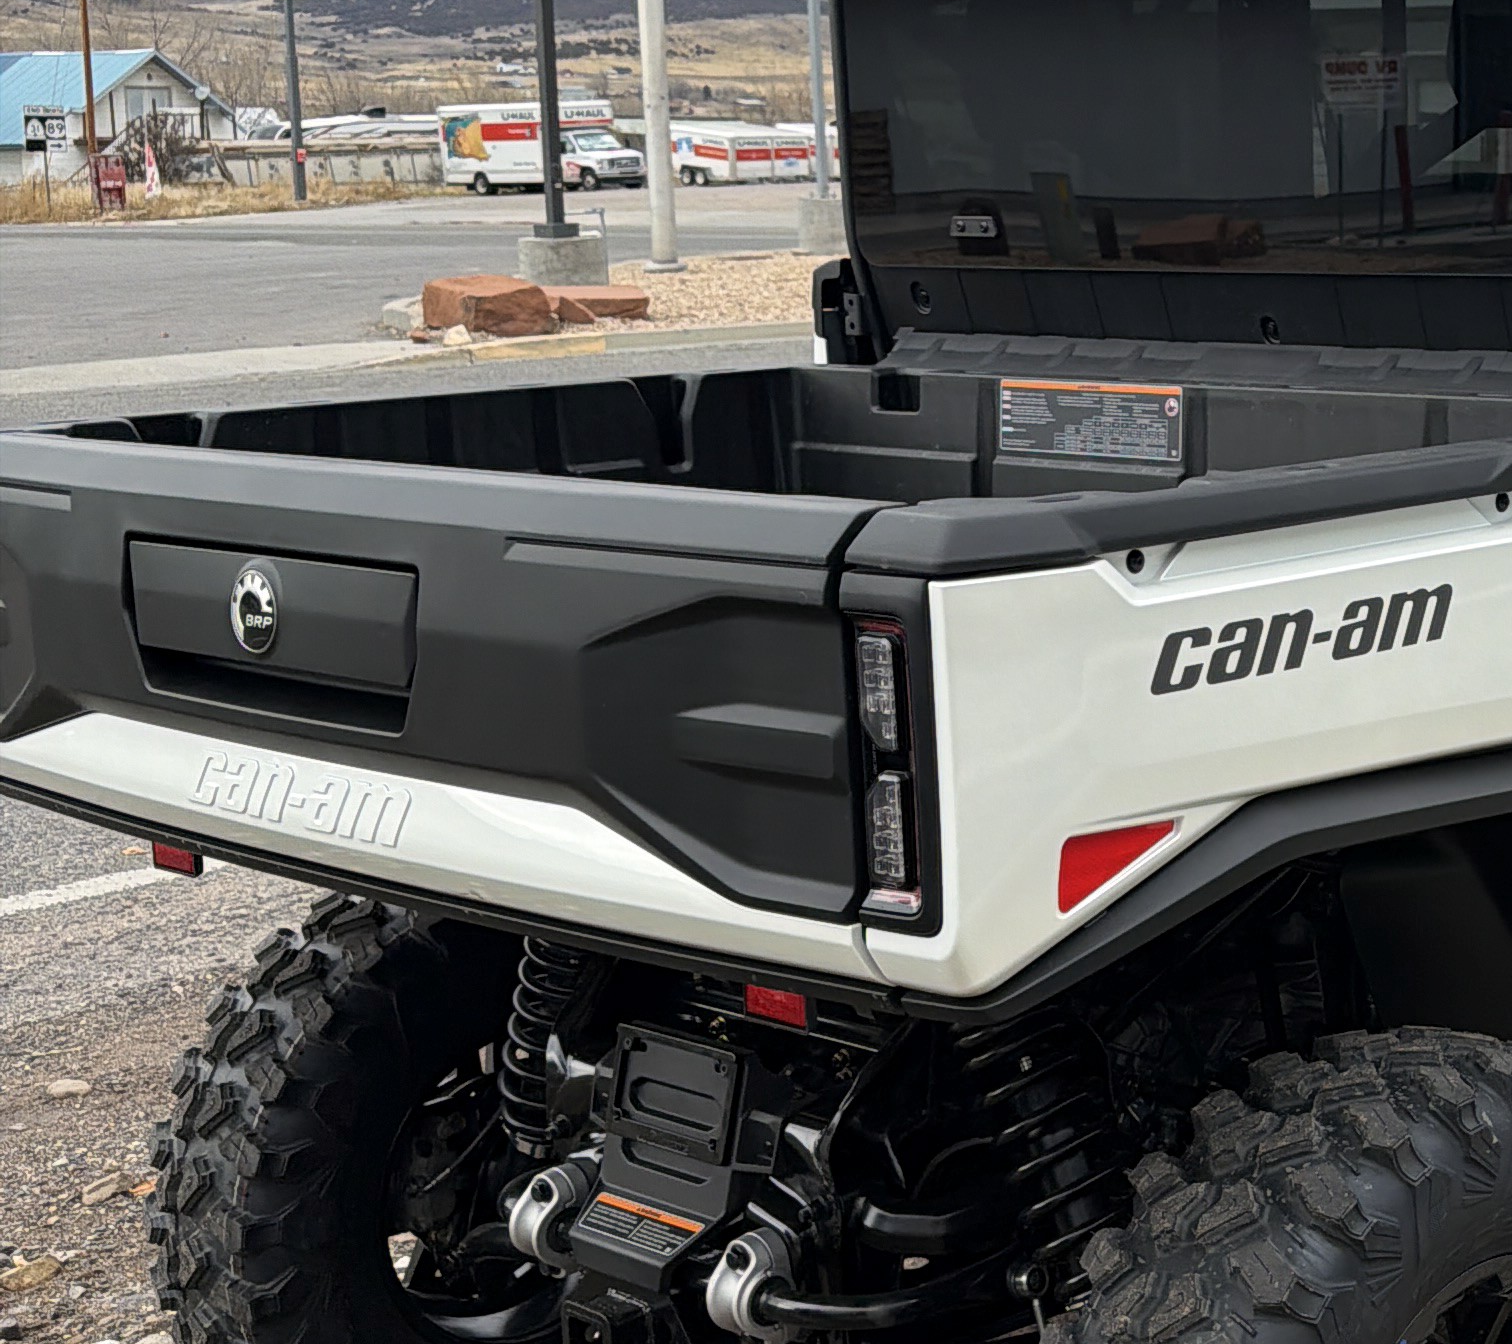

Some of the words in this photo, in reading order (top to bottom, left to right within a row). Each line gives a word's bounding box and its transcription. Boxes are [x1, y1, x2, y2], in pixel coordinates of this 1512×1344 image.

[47, 122, 65, 135] 89
[245, 613, 273, 629] BRP
[1150, 583, 1453, 696] can-am
[188, 750, 413, 848] can-am
